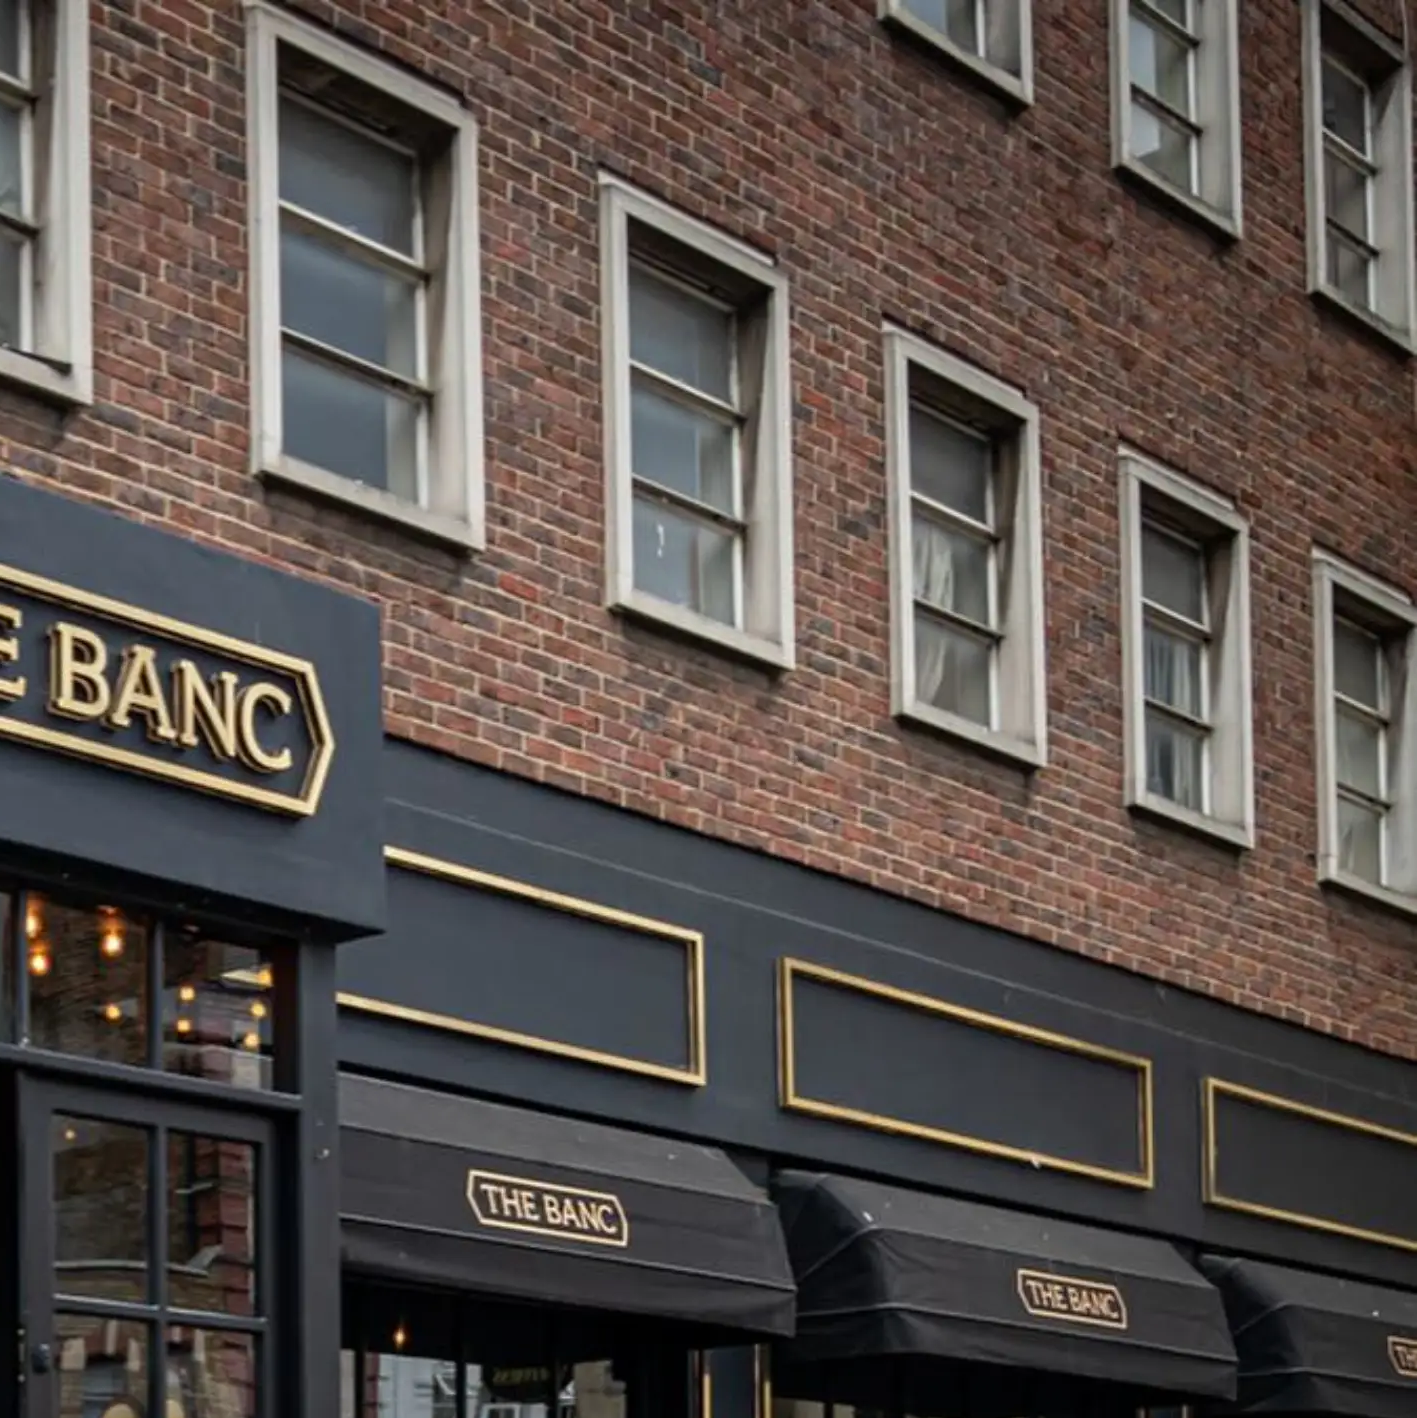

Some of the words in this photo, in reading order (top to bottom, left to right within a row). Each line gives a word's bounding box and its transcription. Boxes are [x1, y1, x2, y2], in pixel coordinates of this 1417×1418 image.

[49, 621, 293, 771] BANC
[479, 1183, 540, 1222] THE
[542, 1194, 617, 1235] BANC
[1025, 1280, 1068, 1310] THE
[1067, 1286, 1119, 1319] BANC
